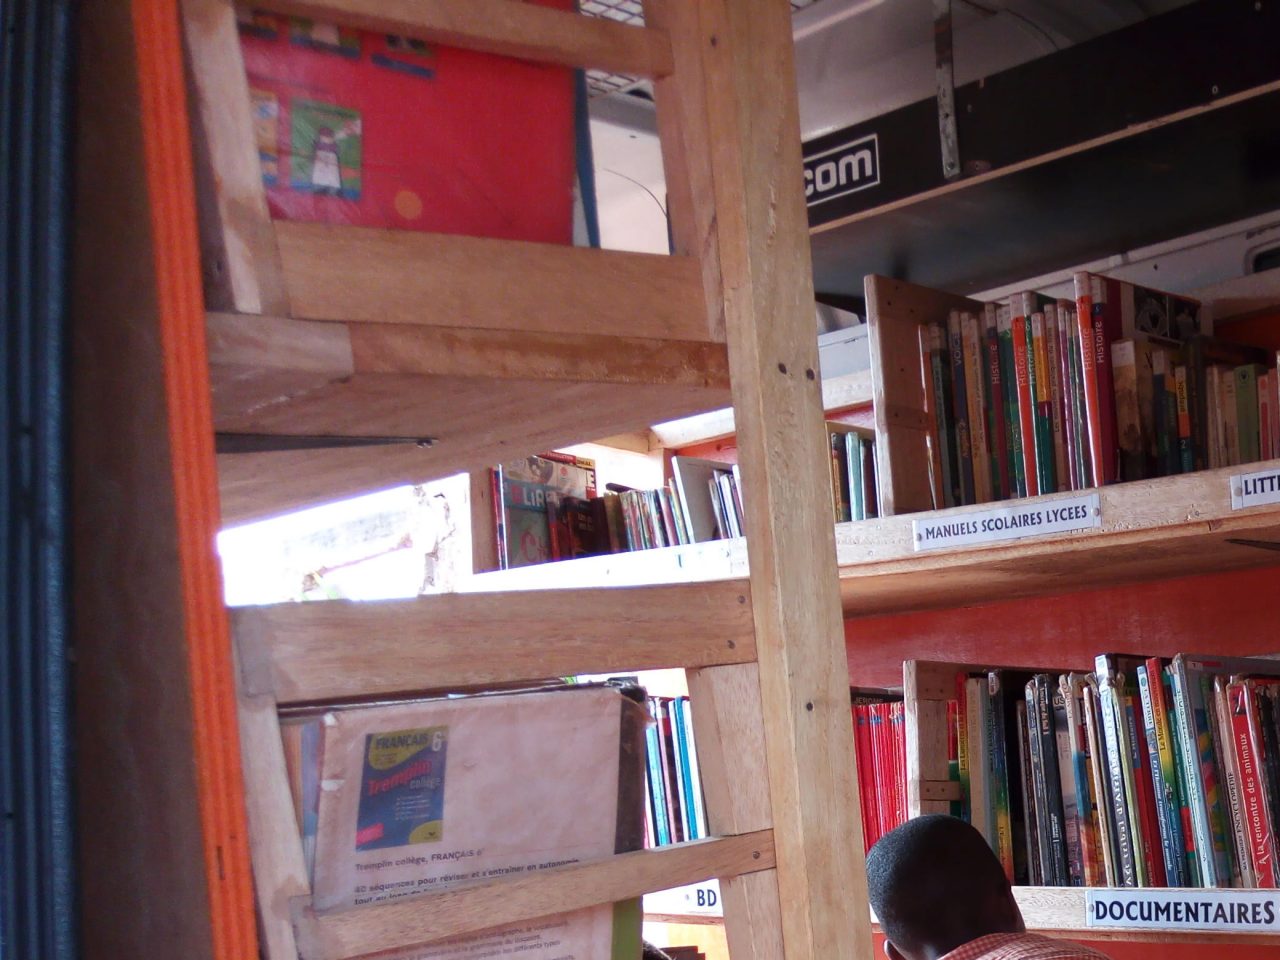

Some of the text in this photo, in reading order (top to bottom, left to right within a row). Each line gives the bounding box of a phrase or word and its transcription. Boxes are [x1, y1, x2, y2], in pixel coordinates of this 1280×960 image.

[1083, 328, 1092, 370] Histoire
[1096, 320, 1105, 364] Histoire
[1018, 345, 1027, 387] Histoire
[925, 521, 978, 540] MANUELS
[981, 511, 1042, 533] SCOLAIRES
[1046, 504, 1087, 523] LYCEES
[1053, 698, 1065, 706] US
[375, 733, 429, 749] FRANÇAIS
[1156, 718, 1165, 742] Monde
[1239, 733, 1253, 775] animaux
[1245, 777, 1255, 794] des
[1248, 796, 1263, 843] rencontre
[1117, 820, 1129, 858] tribal
[355, 856, 394, 872] Tremplin
[417, 875, 438, 887] pour
[440, 872, 469, 884] réviser
[526, 864, 537, 872] en
[354, 896, 374, 905] tout
[696, 889, 717, 907] BD
[1095, 901, 1275, 925] DOCUMENTAIRES
